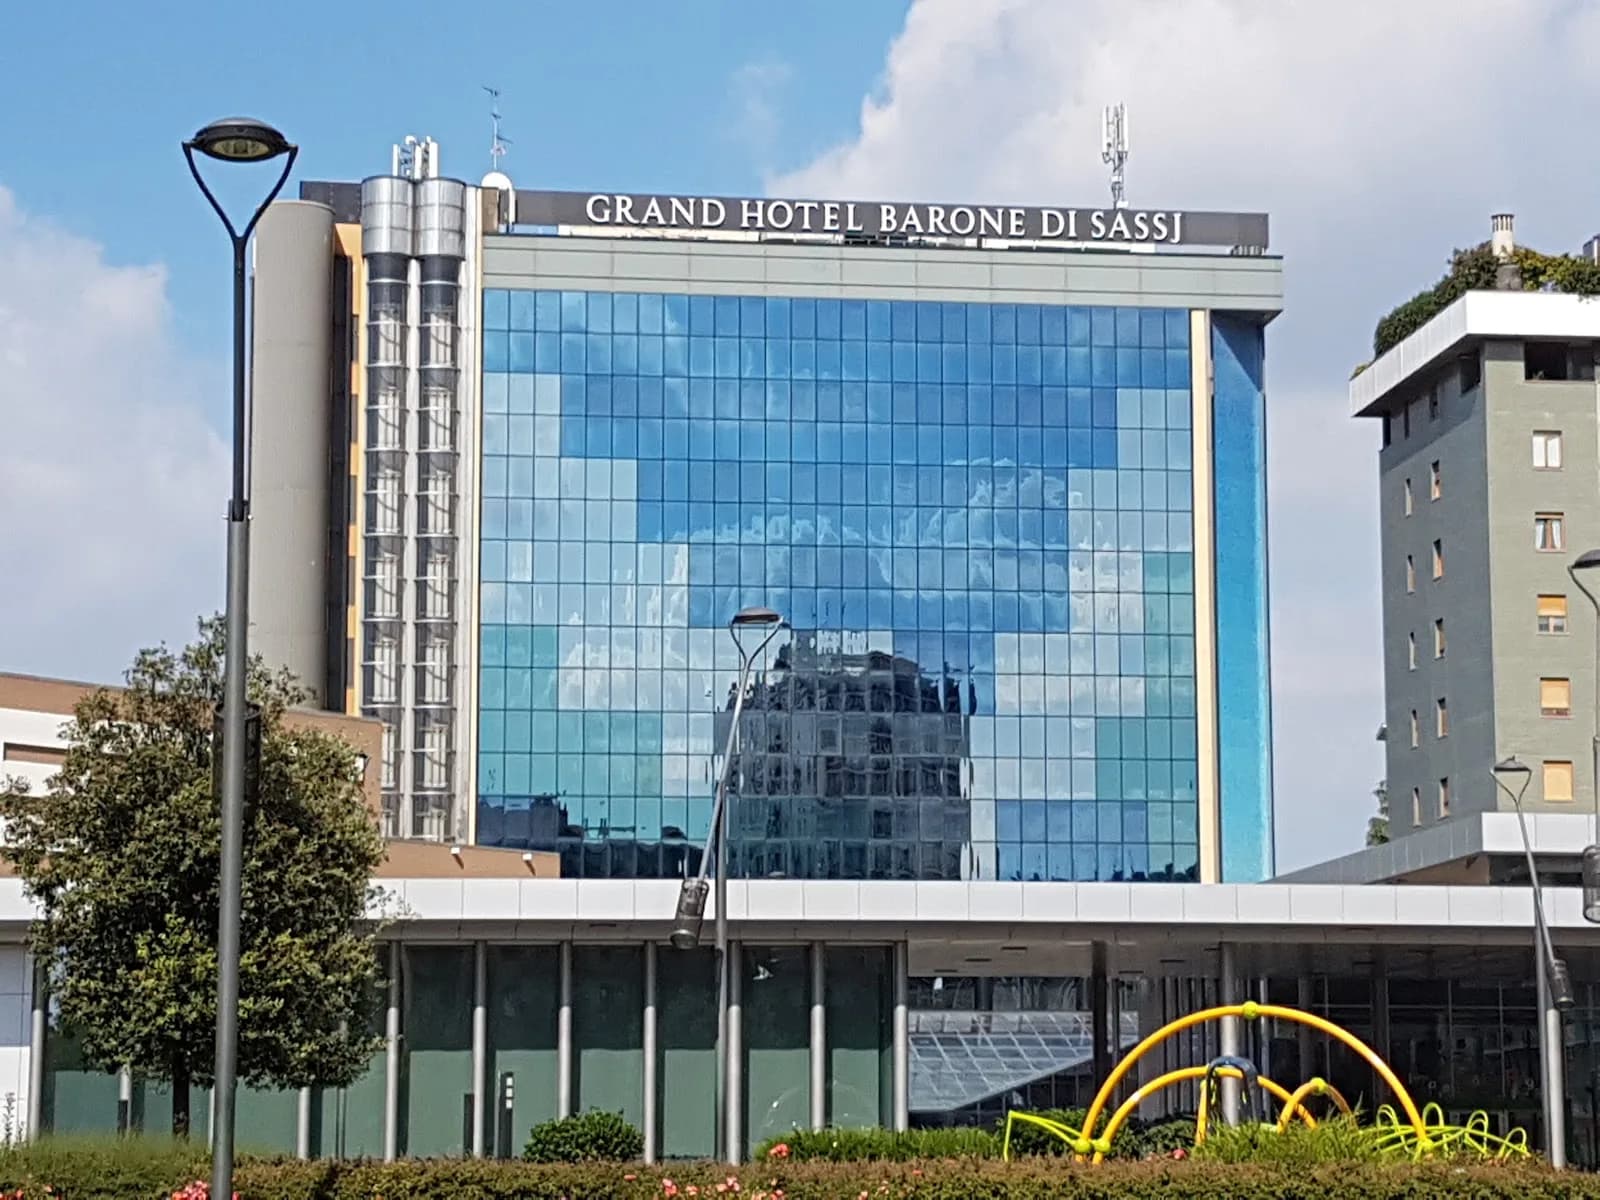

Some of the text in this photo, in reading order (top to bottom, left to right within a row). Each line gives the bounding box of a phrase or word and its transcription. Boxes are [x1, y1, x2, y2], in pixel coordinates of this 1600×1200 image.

[586, 194, 1182, 243] GRAND HOTEL BARONE DI SASSJ
